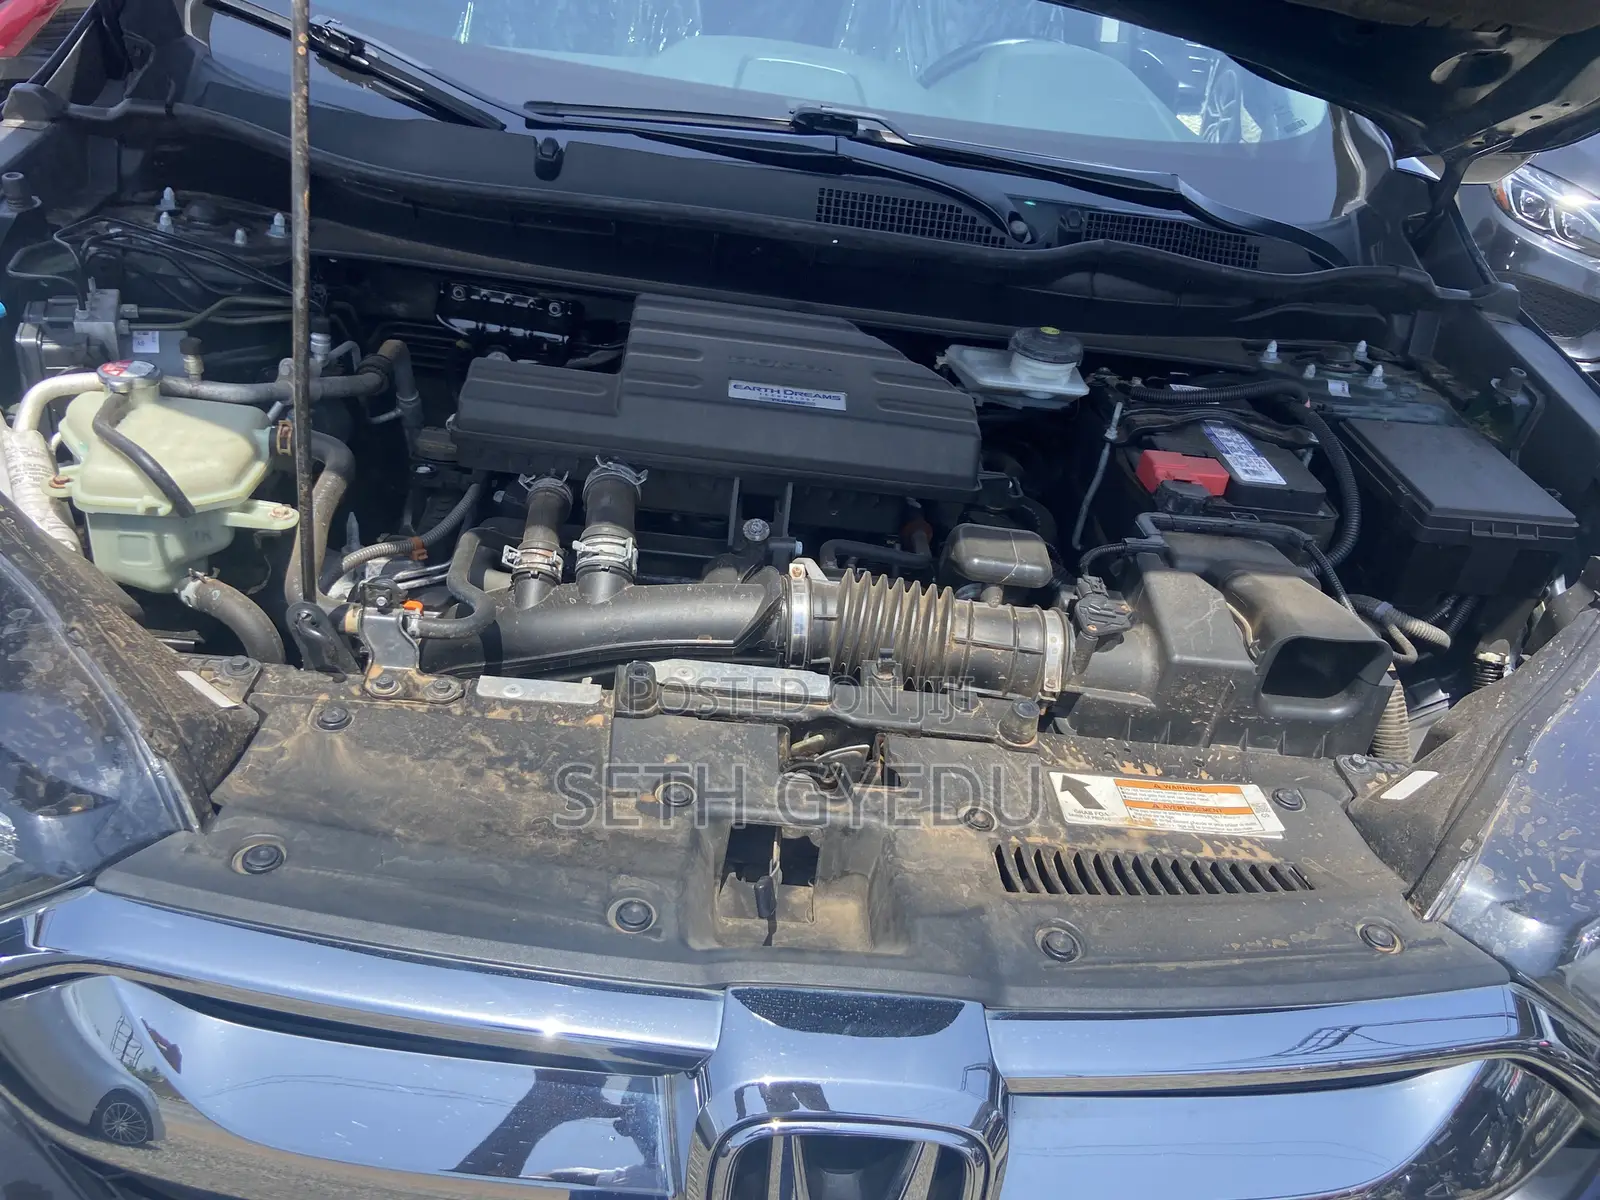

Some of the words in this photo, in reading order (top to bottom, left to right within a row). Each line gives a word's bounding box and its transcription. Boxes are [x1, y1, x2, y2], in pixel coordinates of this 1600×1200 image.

[733, 384, 781, 395] EARTH
[783, 389, 842, 401] DREAMS
[1163, 784, 1202, 792] WARNING
